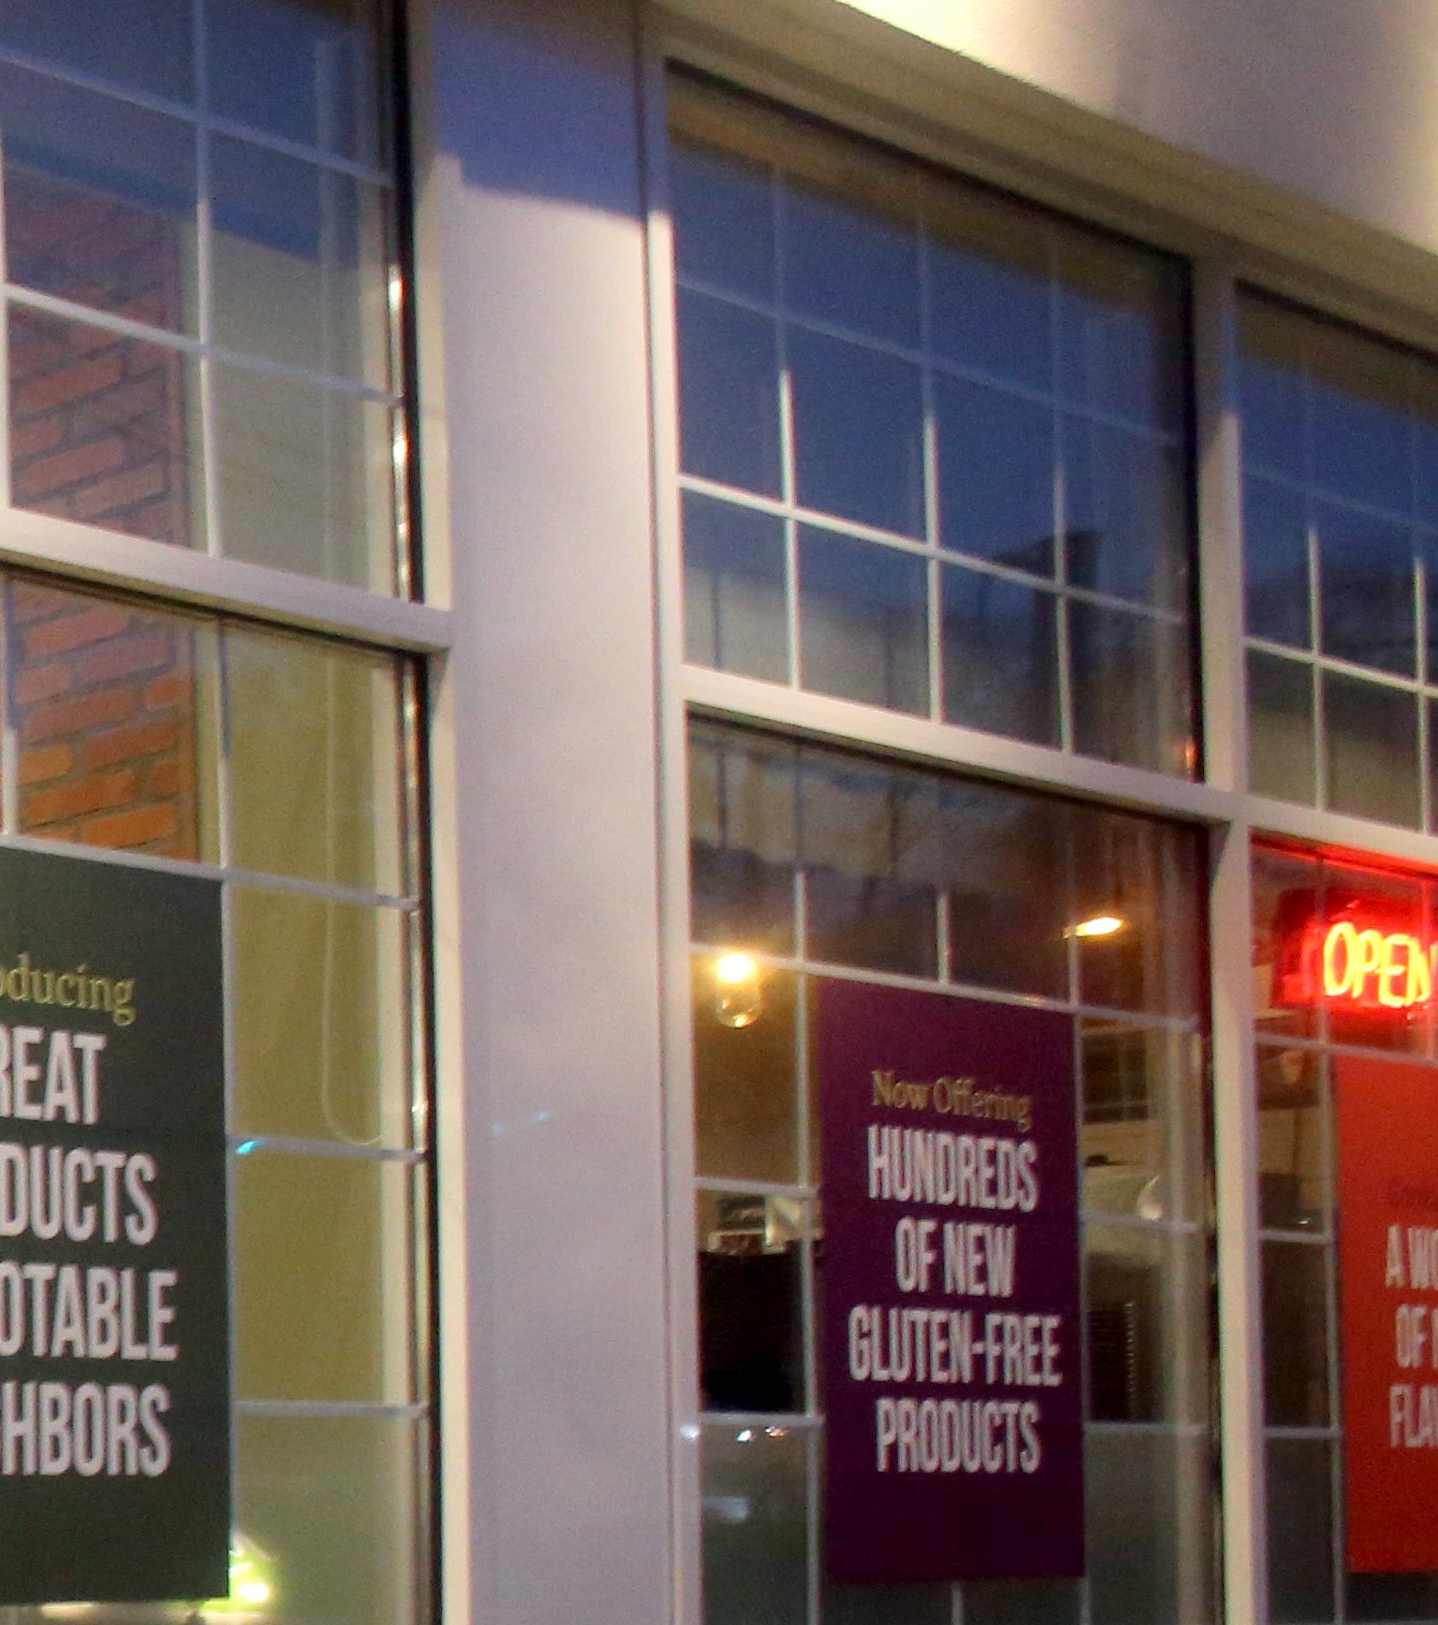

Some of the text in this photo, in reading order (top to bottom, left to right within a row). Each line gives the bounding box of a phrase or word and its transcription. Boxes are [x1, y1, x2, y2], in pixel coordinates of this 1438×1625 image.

[1323, 921, 1438, 1009] OPEN
[871, 1068, 1033, 1133] Now Offering
[867, 1123, 1041, 1213] HUNDREDS
[894, 1216, 1018, 1298] OF NEW
[1385, 1224, 1405, 1289] A
[847, 1303, 1063, 1387] GLUTEN-FREE
[1395, 1303, 1428, 1369] OF
[875, 1398, 1043, 1475] PRODUCTS
